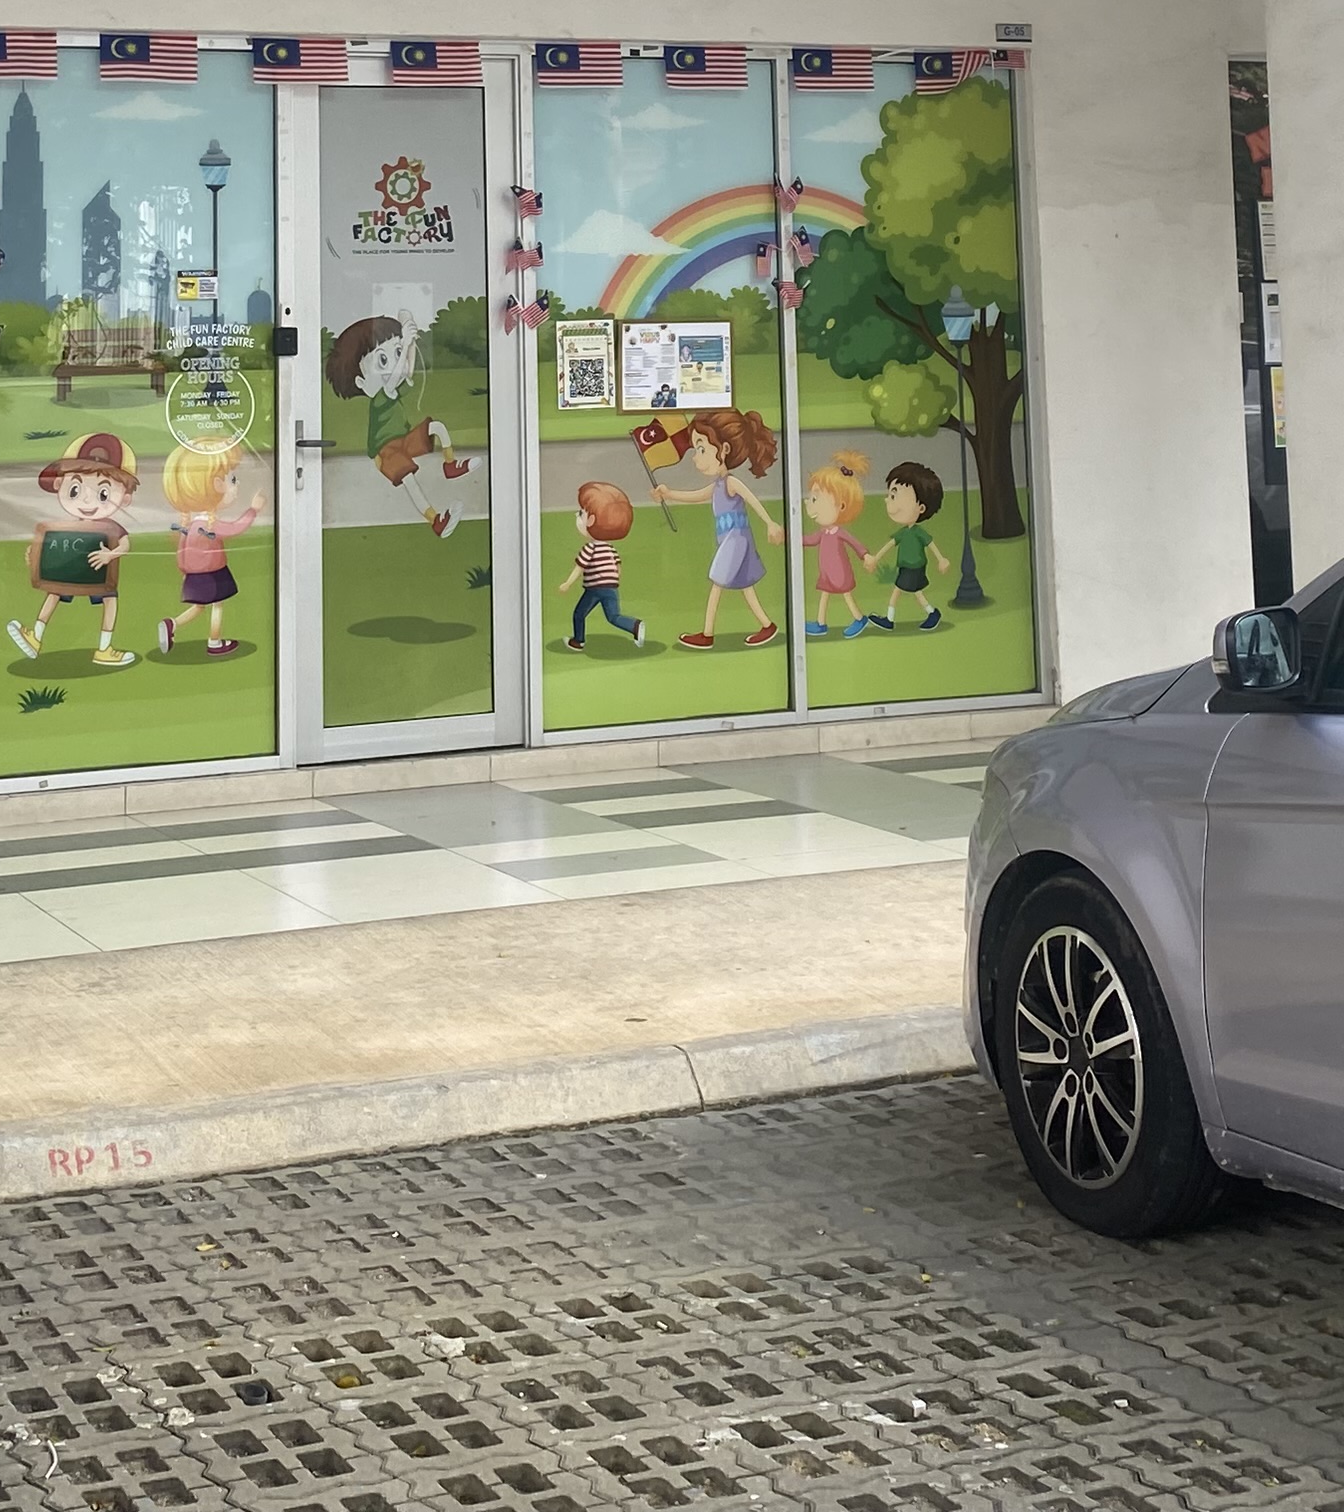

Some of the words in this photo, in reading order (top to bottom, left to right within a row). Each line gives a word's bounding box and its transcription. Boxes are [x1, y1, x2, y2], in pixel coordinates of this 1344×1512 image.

[1003, 26, 1025, 36] G-05
[358, 211, 397, 227] THE
[405, 205, 451, 228] FUN
[352, 221, 454, 246] FACTORY
[170, 326, 189, 336] THE
[191, 324, 209, 335] FUN
[211, 324, 252, 335] FACTORY
[166, 338, 193, 350] CHILD
[195, 336, 219, 347] CARE
[221, 336, 255, 348] CENTRE
[181, 357, 241, 371] OPENING
[187, 371, 234, 384] HOURS
[216, 412, 244, 420] SUNDAY
[197, 421, 224, 429] CLOSED
